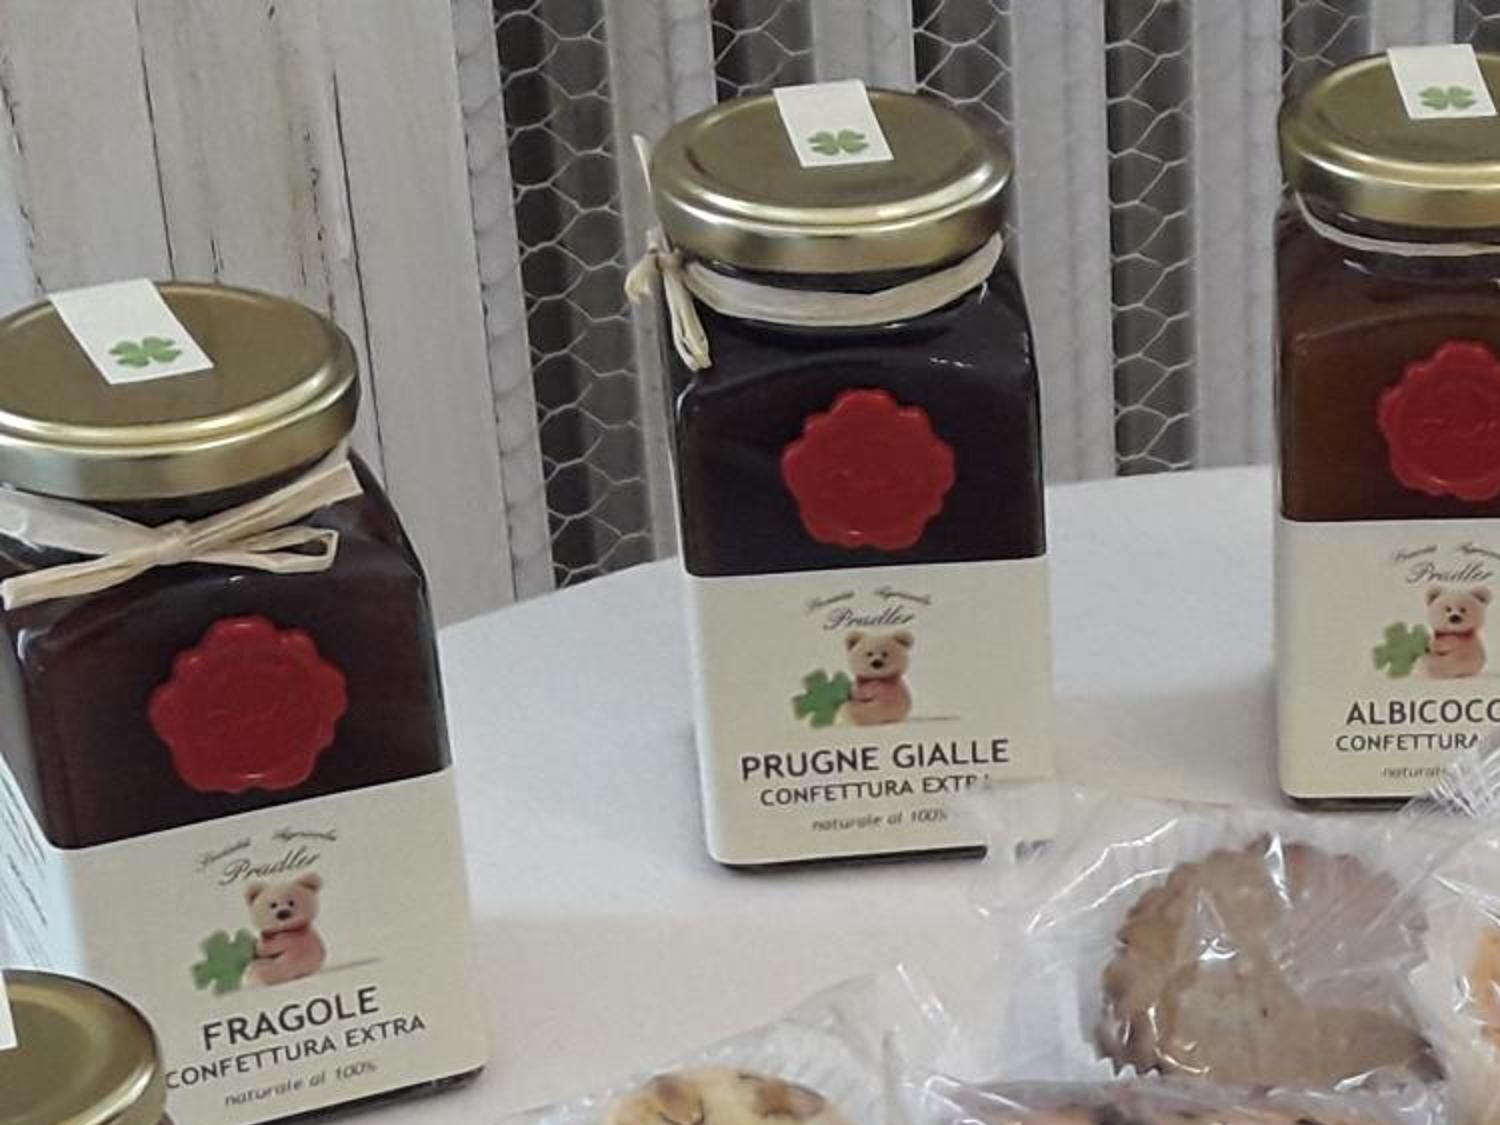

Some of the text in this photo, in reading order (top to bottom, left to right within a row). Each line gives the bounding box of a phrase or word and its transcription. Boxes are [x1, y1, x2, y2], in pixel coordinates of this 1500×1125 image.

[741, 739, 1010, 781] PRUGNE GIALLE
[760, 780, 914, 807] CONFETTURA
[812, 813, 881, 831] naturale
[203, 986, 380, 1051] FRAGOLE
[165, 1015, 426, 1089] CONFETTURA EXTRA
[225, 1060, 378, 1106] naturale al 100%
